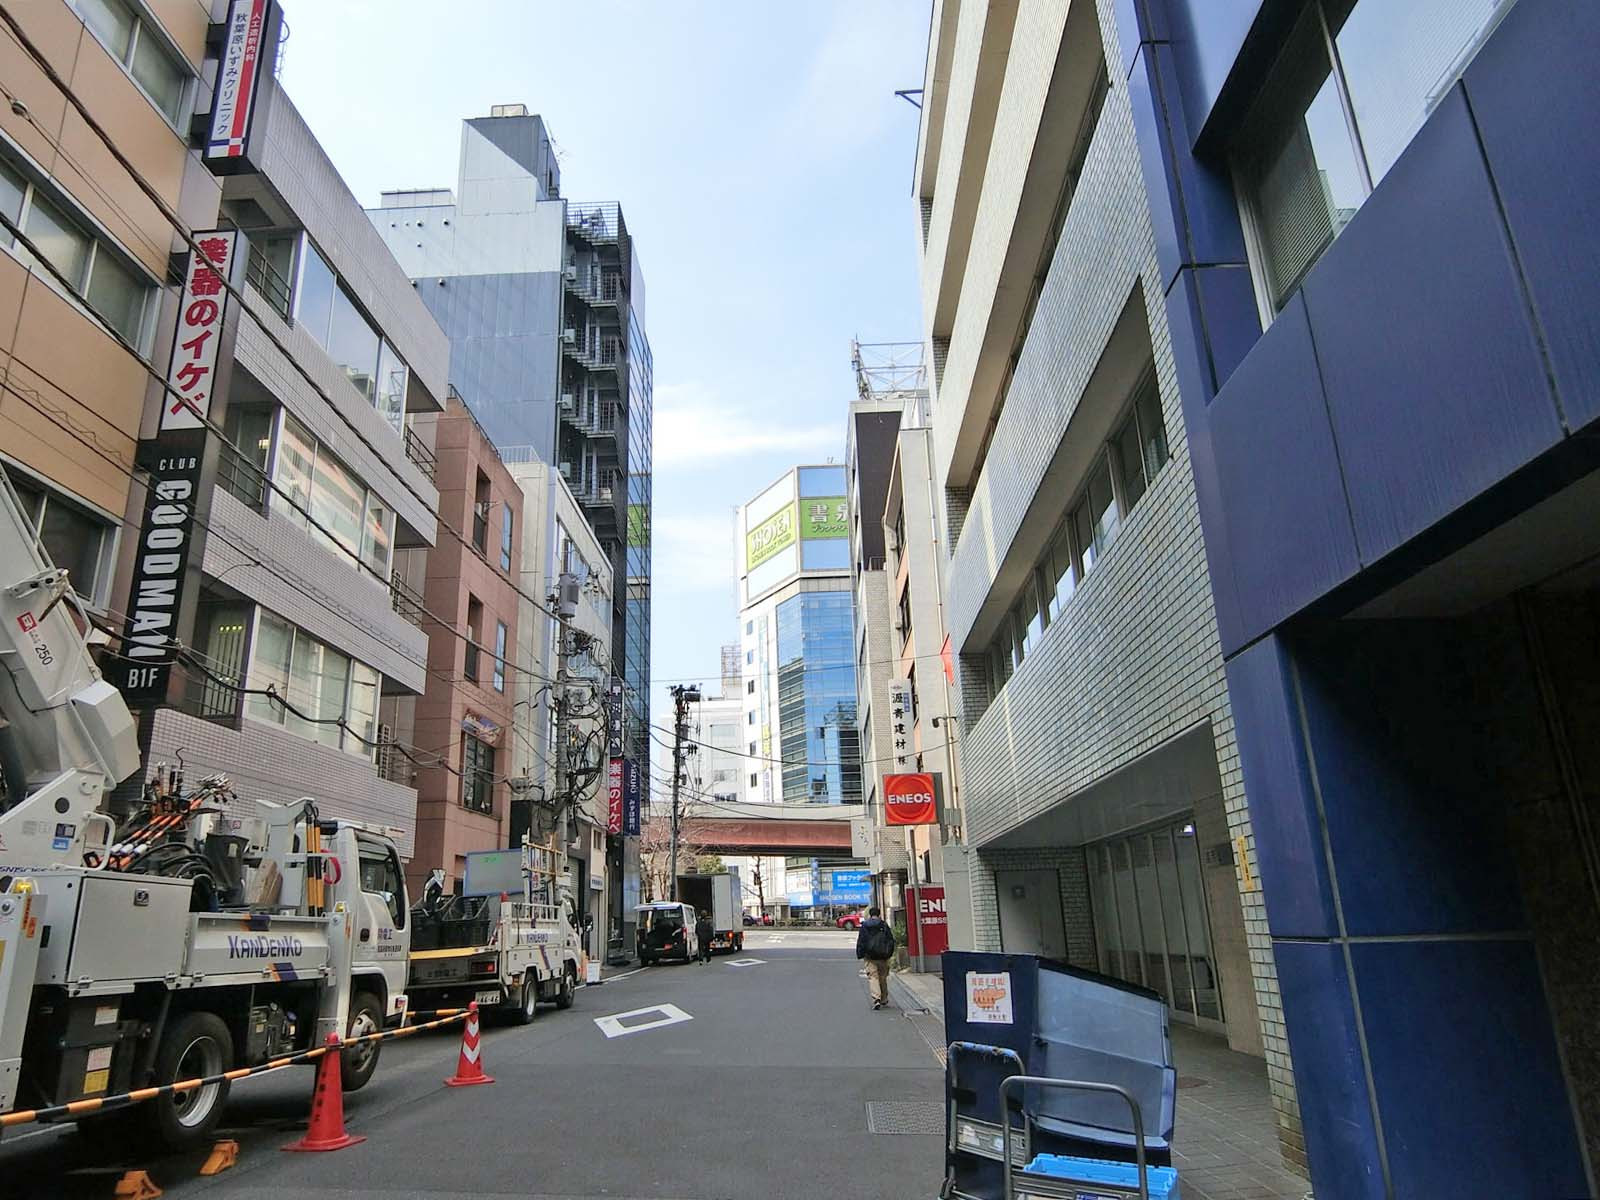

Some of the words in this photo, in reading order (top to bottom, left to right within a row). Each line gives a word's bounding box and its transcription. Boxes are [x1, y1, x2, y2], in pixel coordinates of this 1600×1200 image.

[217, 12, 248, 135] 秋葉原いずみクリニック
[170, 237, 229, 416] 楽器のイケベ
[159, 457, 197, 471] CLUB
[128, 479, 193, 657] GOODMAN
[35, 644, 53, 666] 250
[127, 668, 159, 689] B1F
[887, 792, 931, 804] ENEOS
